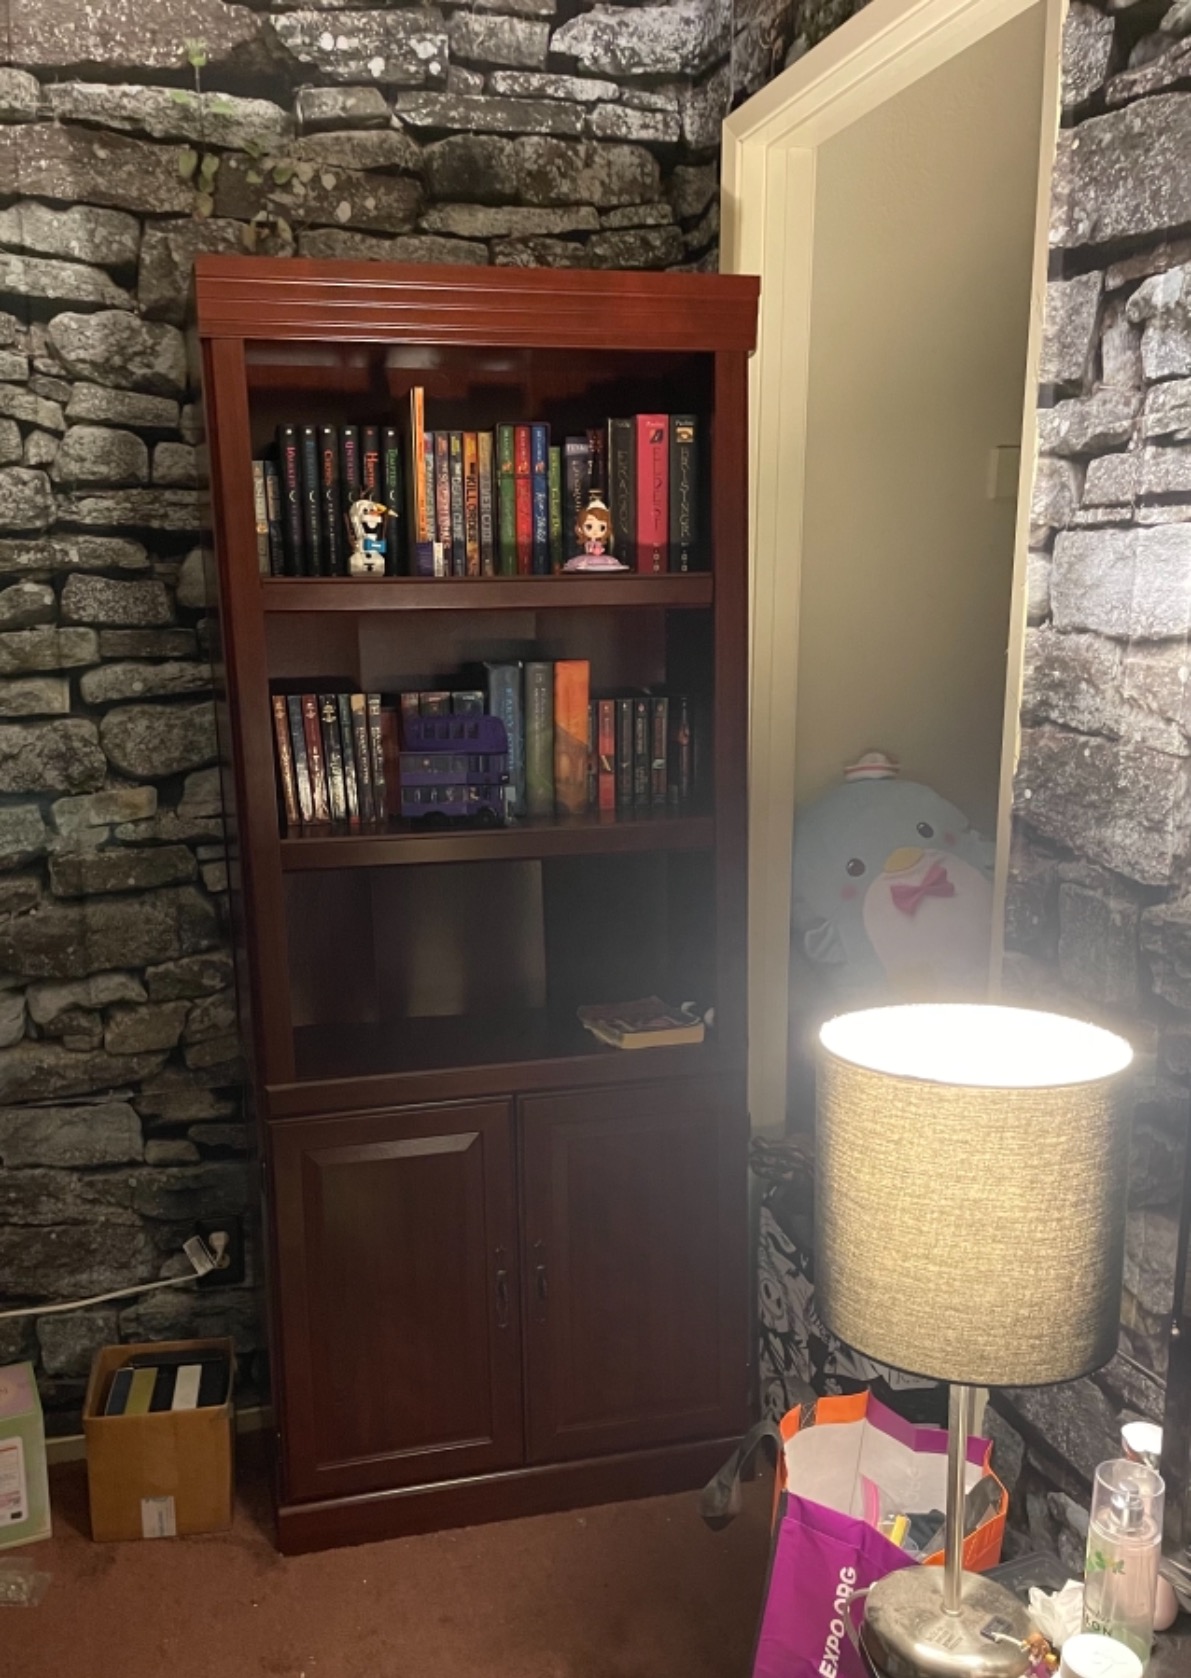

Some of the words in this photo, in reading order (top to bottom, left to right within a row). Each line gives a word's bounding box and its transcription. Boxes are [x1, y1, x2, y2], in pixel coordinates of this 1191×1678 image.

[467, 476, 477, 503] KILL
[653, 447, 663, 531] ELDEST
[818, 1566, 857, 1678] EXPOORG
